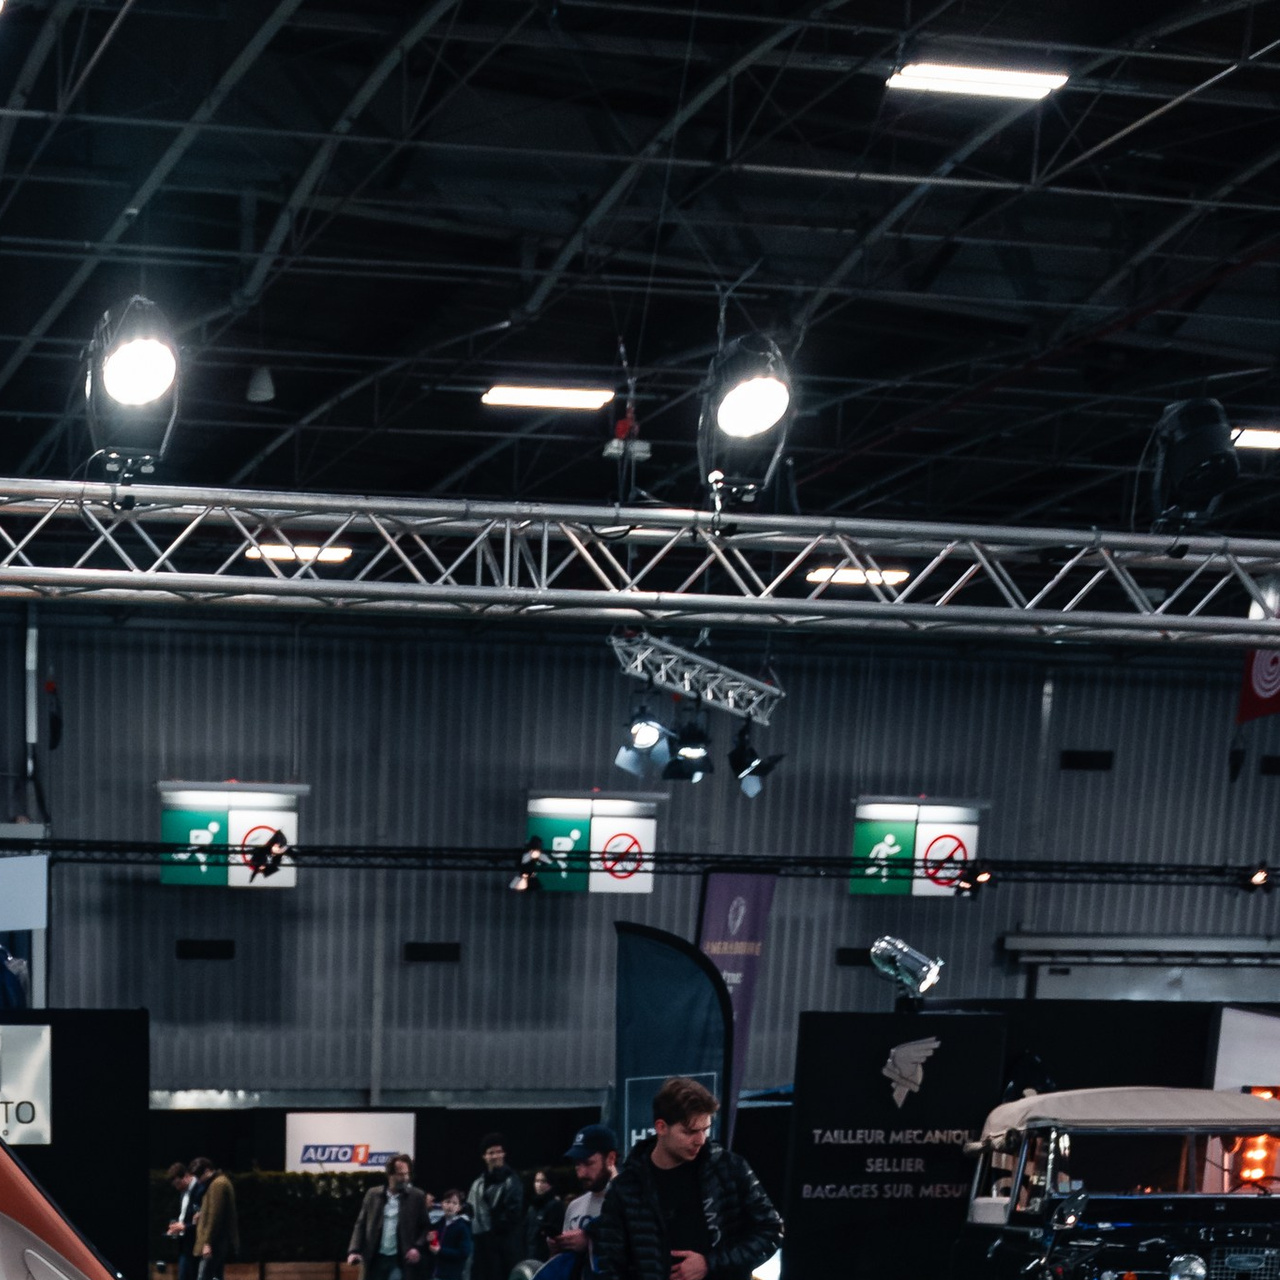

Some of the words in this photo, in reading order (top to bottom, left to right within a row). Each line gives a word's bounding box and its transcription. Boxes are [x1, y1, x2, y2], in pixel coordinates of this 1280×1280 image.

[812, 1129, 886, 1145] TAILLEUR
[865, 1158, 925, 1173] SELLIER
[802, 1184, 879, 1199] BAGAGES
[882, 1184, 914, 1199] SUR
